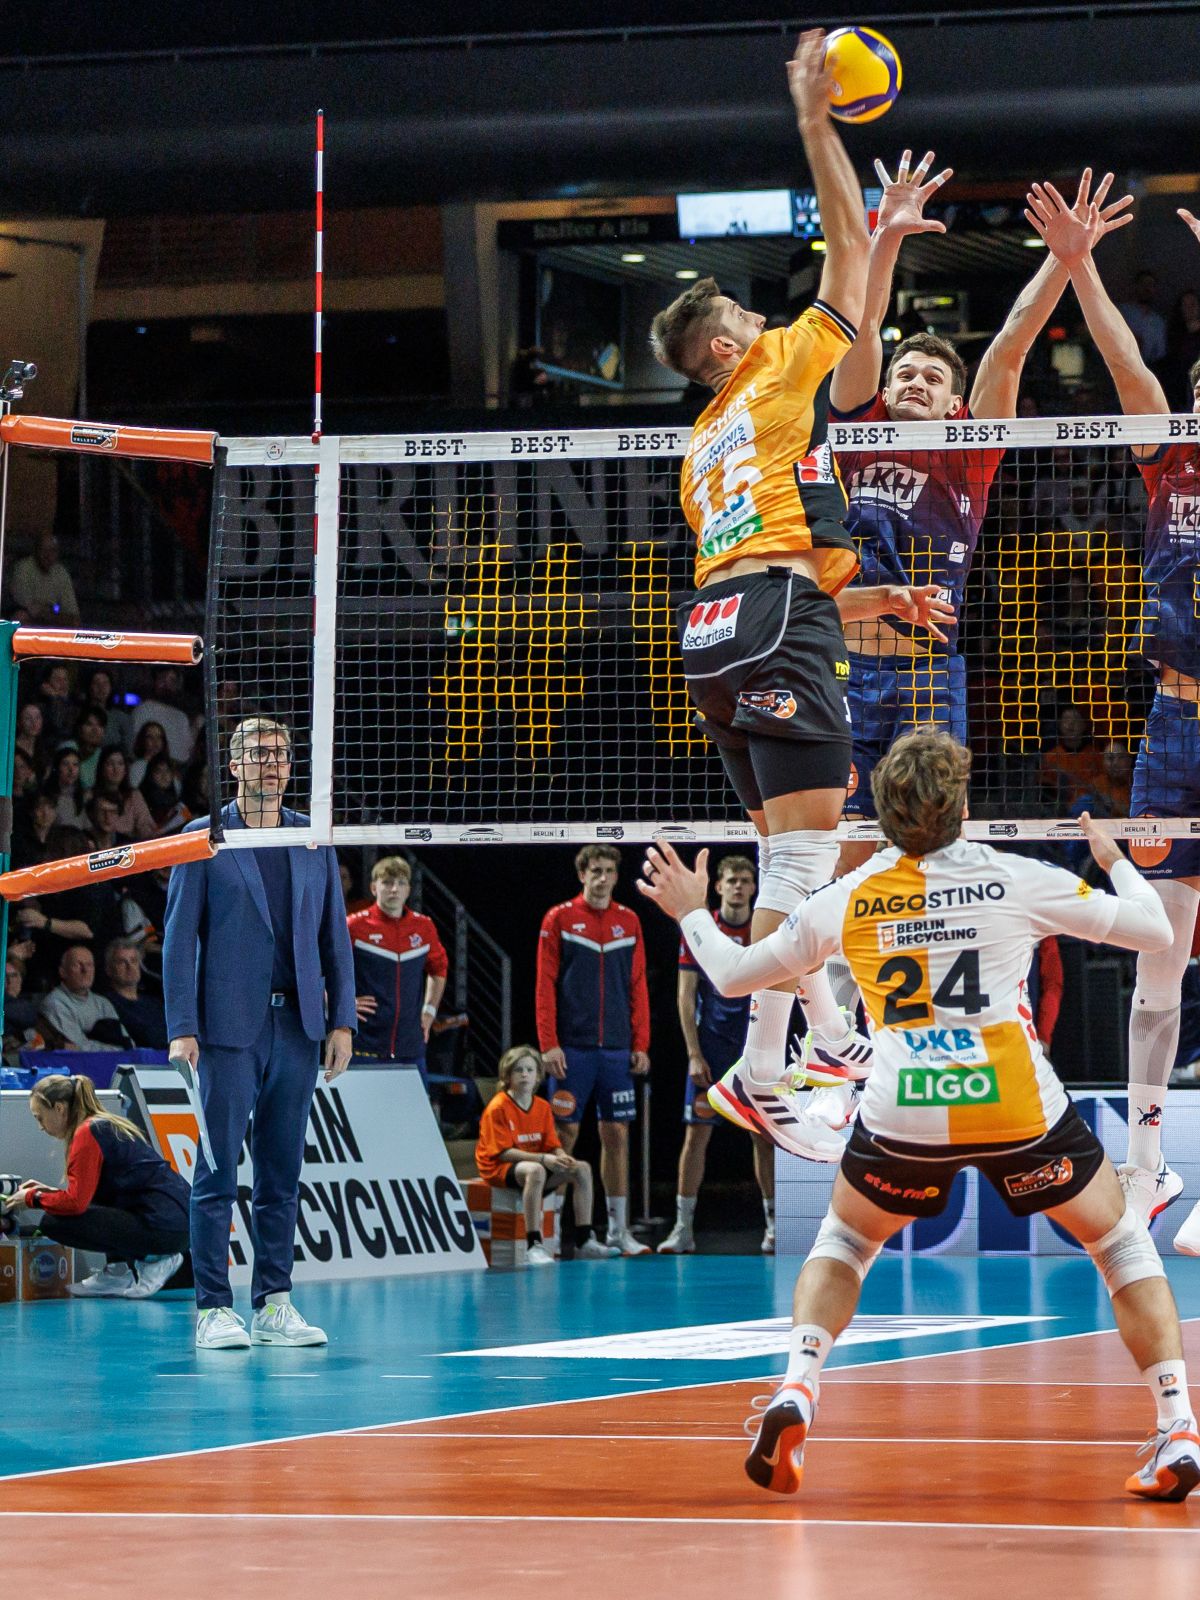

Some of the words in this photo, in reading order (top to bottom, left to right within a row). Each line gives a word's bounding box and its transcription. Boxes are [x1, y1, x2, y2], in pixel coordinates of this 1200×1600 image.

[683, 626, 733, 648] Securitas
[854, 881, 1006, 918] DAGOSTINO
[896, 918, 945, 933] BERLIN
[896, 928, 978, 946] RECYCLING
[876, 949, 990, 1025] 24
[904, 1028, 976, 1052] DKB
[904, 1072, 992, 1100] LIGO
